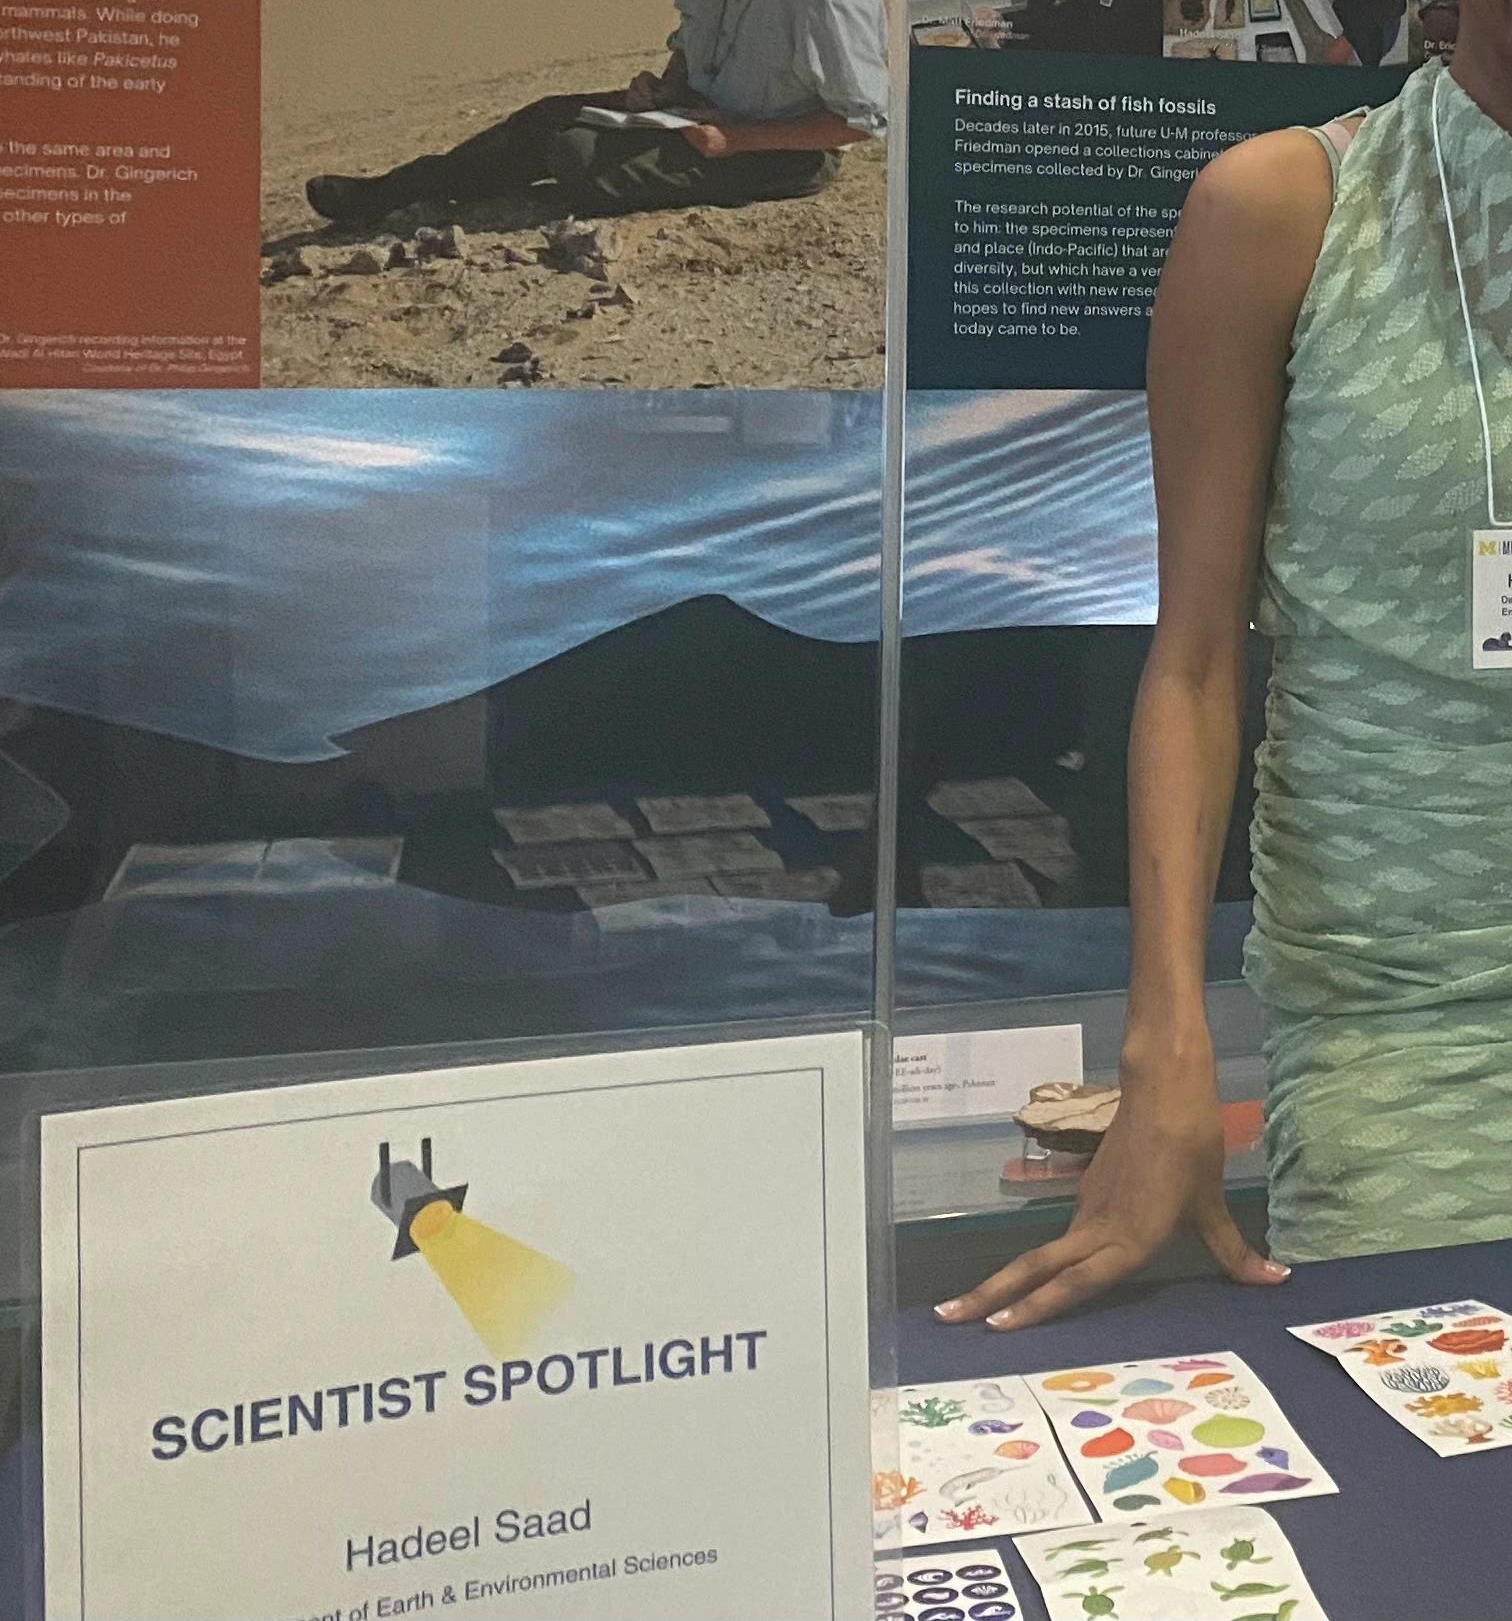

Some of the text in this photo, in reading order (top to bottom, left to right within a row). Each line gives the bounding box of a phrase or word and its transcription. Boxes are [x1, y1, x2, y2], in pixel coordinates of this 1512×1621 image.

[97, 7, 146, 23] While
[151, 10, 199, 28] doing
[0, 28, 180, 47] rthwest Pakistan, he
[58, 52, 88, 66] like
[93, 52, 177, 69] Pakicetus
[67, 75, 85, 88] of
[91, 75, 117, 89] the
[123, 78, 165, 93] early
[955, 89, 1216, 115] Finding a stash of fish fossils
[955, 119, 1019, 133] Decades
[1024, 121, 1055, 135] later
[1059, 121, 1069, 136] in
[1074, 123, 1112, 139] 2015,
[1117, 124, 1156, 139] future
[1161, 127, 1188, 140] U-M
[8, 140, 170, 158] the same area and
[955, 139, 1021, 155] Friedman
[1025, 142, 1079, 159] opened
[1083, 145, 1091, 156] a
[1095, 145, 1171, 159] collections
[0, 164, 80, 179] ecimens.
[115, 166, 198, 183] Gingerich
[955, 161, 1032, 176] specimens
[1037, 162, 1103, 177] collected
[1108, 165, 1124, 180] by
[1150, 166, 1199, 181] Gingeri
[0, 186, 132, 202] ecimens in the
[3, 209, 127, 227] other types of
[955, 200, 981, 213] The
[986, 202, 1048, 216] research
[1052, 203, 1113, 218] potential
[1117, 205, 1132, 217] of
[1136, 206, 1157, 218] the
[955, 222, 968, 234] to
[1006, 222, 1027, 235] the
[1032, 223, 1108, 237] specimens
[954, 242, 980, 255] and
[985, 242, 1024, 256] place
[1028, 243, 1118, 258] (Indo-Pacific)
[1122, 244, 1148, 258] that
[954, 262, 1162, 278] diversity, but which have a ver
[954, 282, 979, 295] this
[983, 282, 1053, 296] collection
[1058, 283, 1085, 297] with
[1090, 287, 1118, 297] new
[954, 302, 998, 317] hopes
[1002, 303, 1016, 316] to
[1021, 302, 1047, 316] find
[1051, 306, 1079, 316] new
[1084, 306, 1141, 317] answers
[954, 322, 1081, 337] today came to be.
[151, 1330, 768, 1461] SCIENTIST SPOTLIGHT
[346, 1498, 592, 1571] Hadeel Saad
[348, 1600, 370, 1621] of
[377, 1589, 434, 1618] Earth
[442, 1584, 457, 1605] &
[465, 1558, 617, 1601] Environmental
[624, 1546, 718, 1574] Sciences
